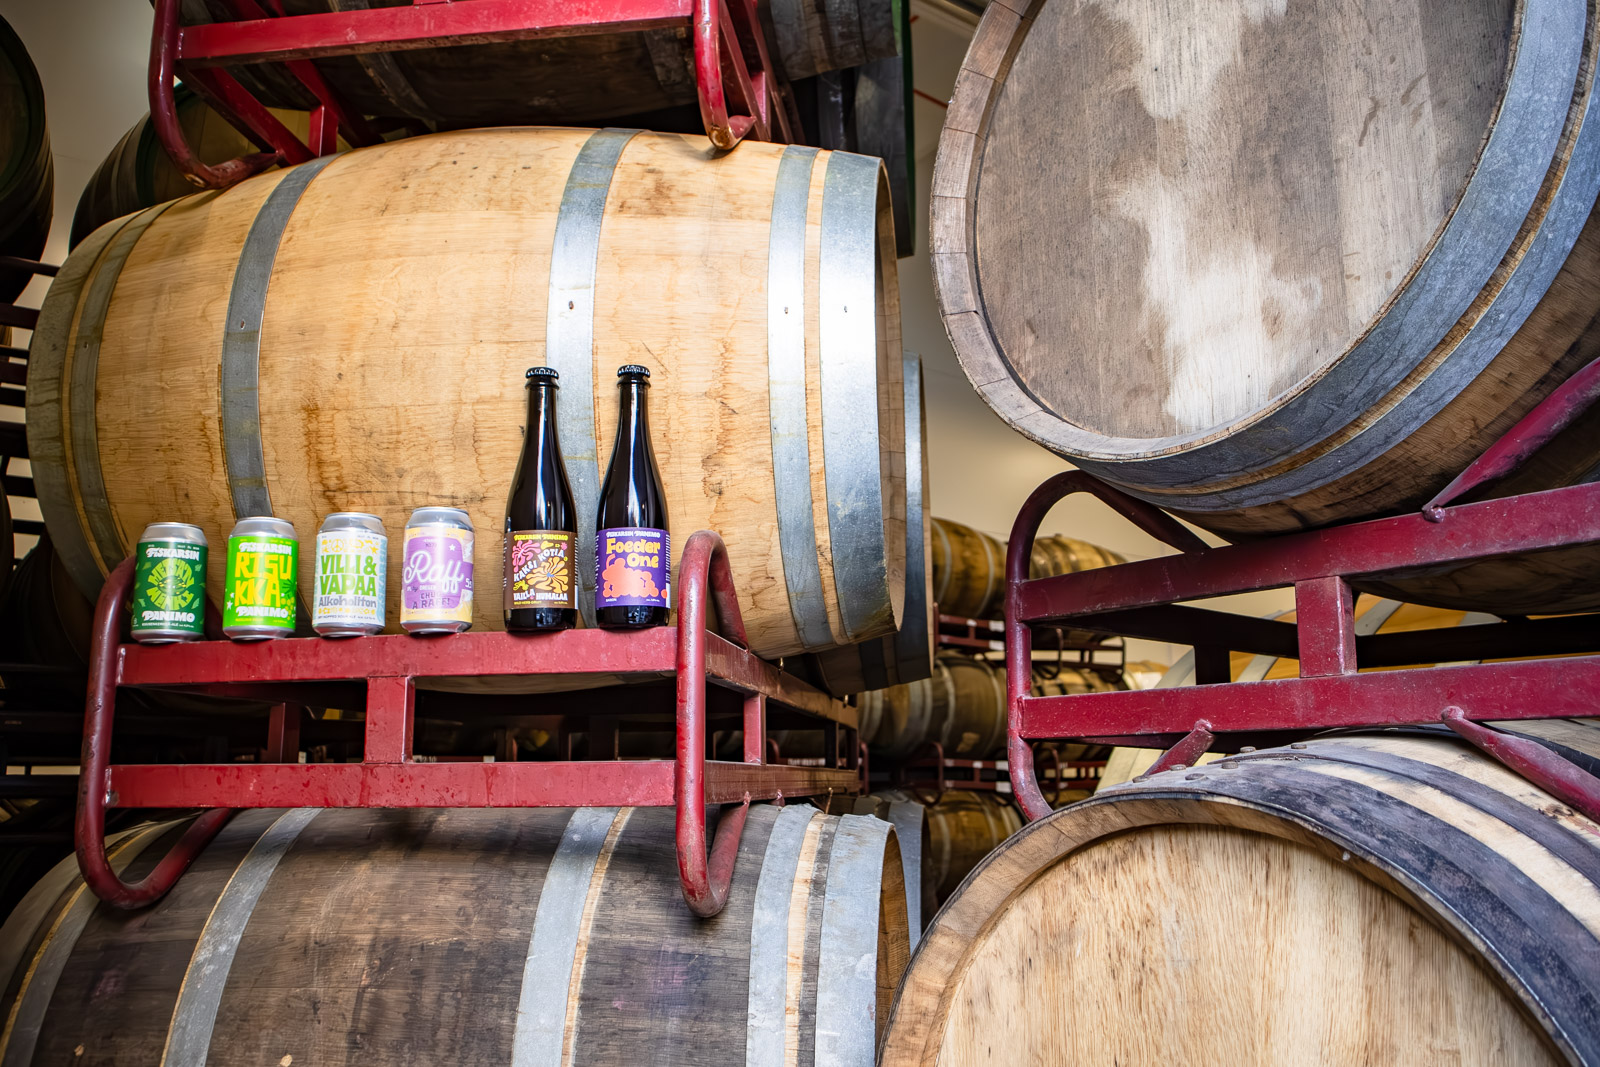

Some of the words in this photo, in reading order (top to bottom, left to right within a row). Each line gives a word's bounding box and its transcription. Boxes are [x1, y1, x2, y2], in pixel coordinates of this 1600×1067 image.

[239, 542, 292, 555] FISKARSIN
[606, 538, 661, 554] Foeder
[146, 547, 199, 561] FISKARSIN
[627, 553, 659, 568] One
[235, 552, 292, 580] RISU
[321, 554, 361, 574] VILLI
[363, 555, 377, 576] &
[404, 551, 464, 593] Raff
[514, 560, 538, 582] KAKSI
[537, 548, 564, 561] KOTIA
[235, 578, 281, 607] KKA
[320, 574, 376, 597] VAPAA
[319, 595, 376, 608] Alkoholiton
[514, 588, 535, 601] VAILLA
[536, 592, 568, 601] HUMALAA
[142, 610, 195, 622] PANIMO
[236, 606, 288, 618] PANIMO
